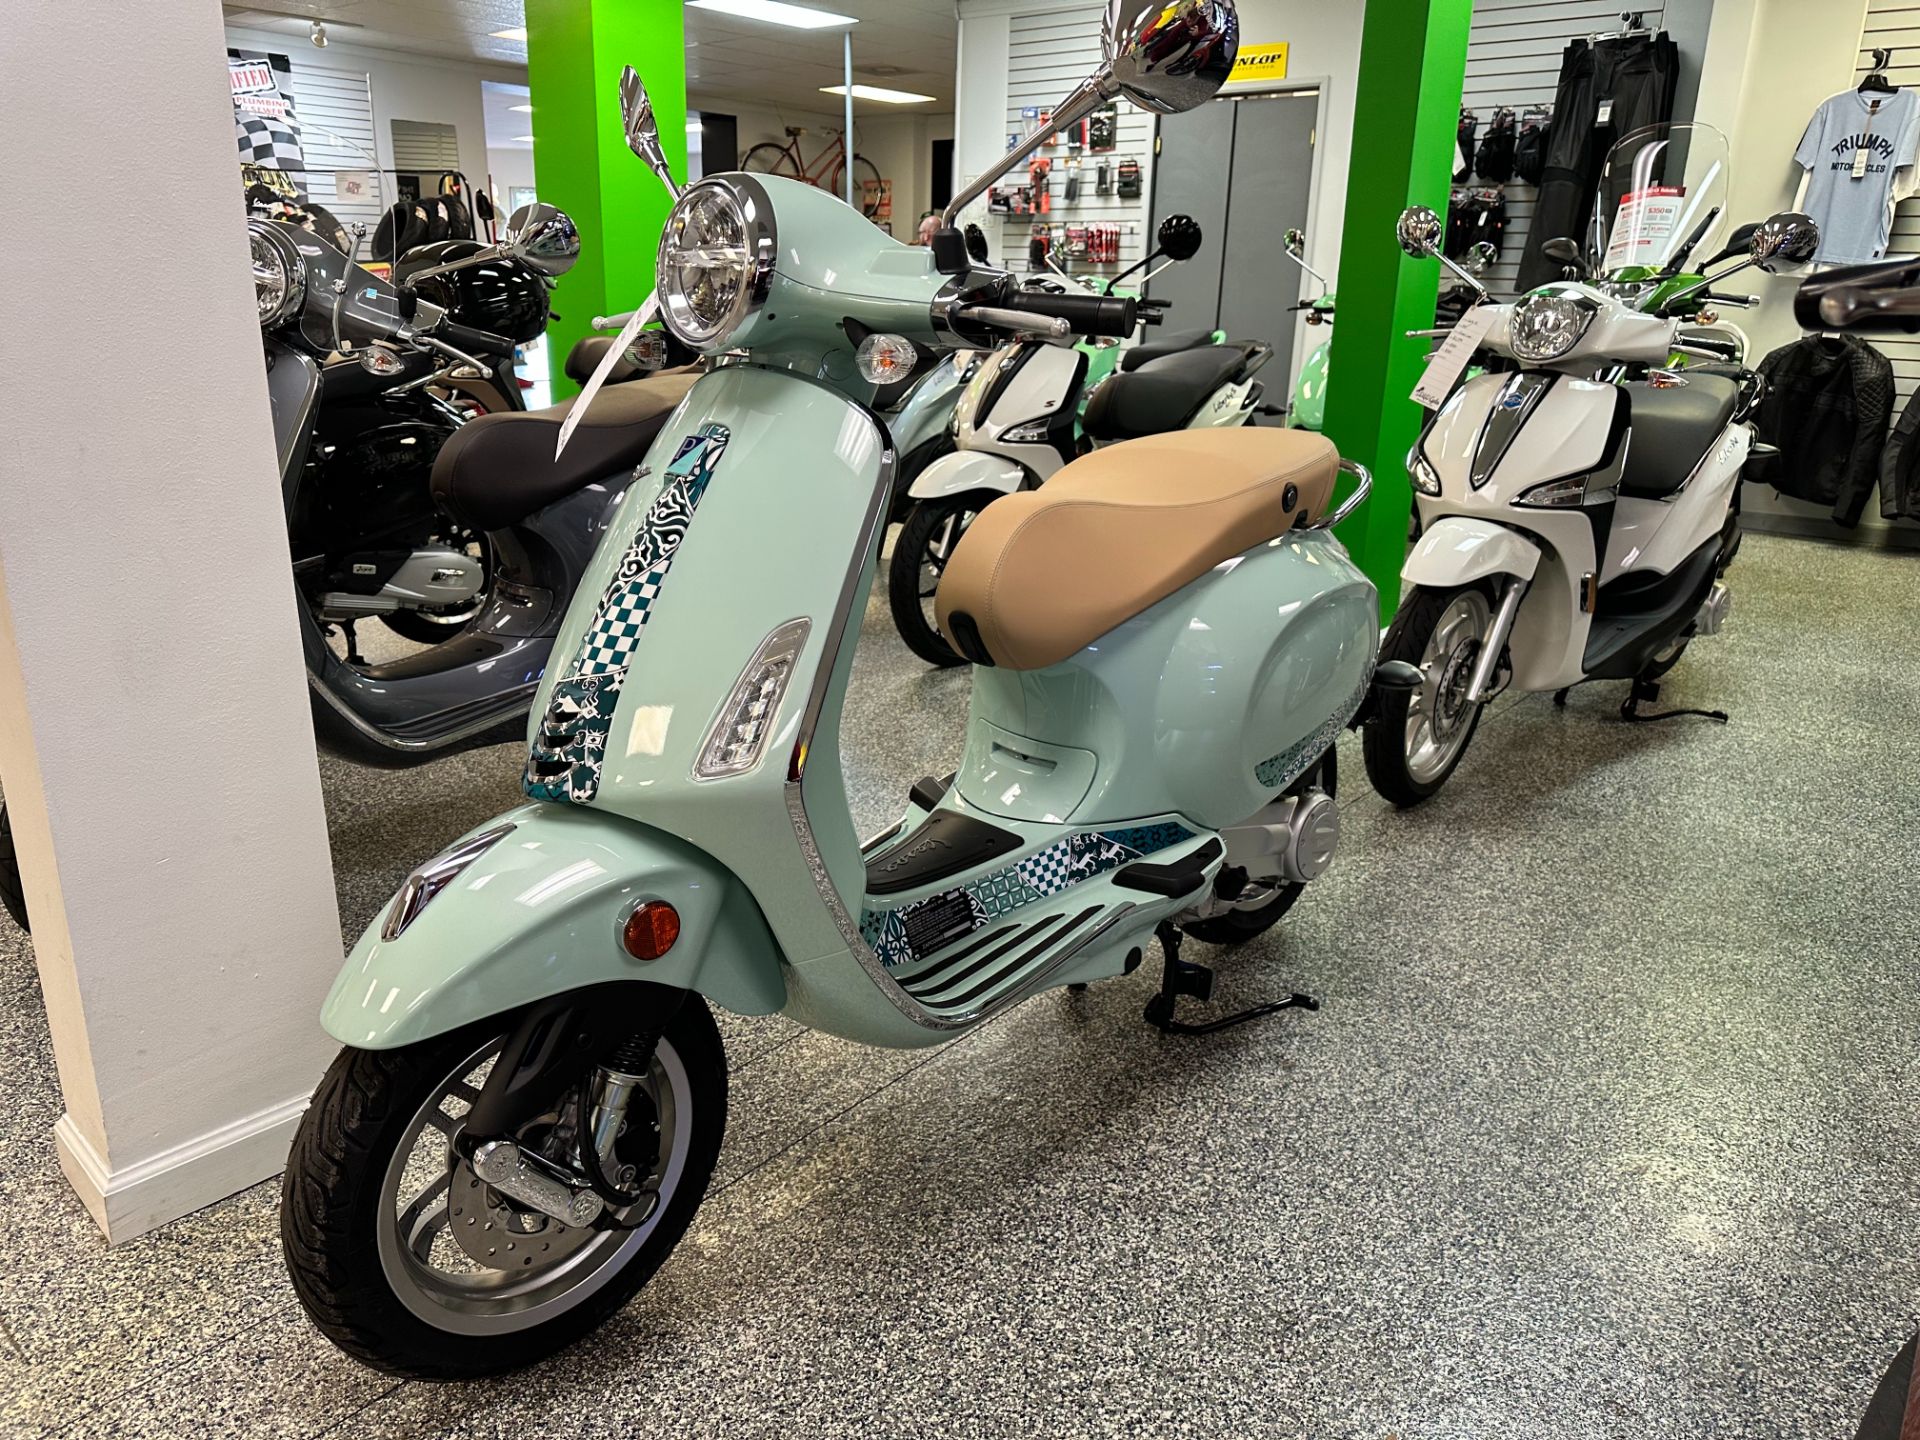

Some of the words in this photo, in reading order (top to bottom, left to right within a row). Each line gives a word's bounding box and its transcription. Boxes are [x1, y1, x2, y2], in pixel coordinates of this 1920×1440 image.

[1234, 54, 1281, 66] NLOP
[231, 67, 269, 89] IFIED
[236, 96, 290, 108] PLUMBING
[1831, 133, 1895, 160] TRIUMPH
[1831, 163, 1886, 173] MOTORCLES
[1044, 400, 1056, 408] S
[878, 838, 953, 873] Vespa
